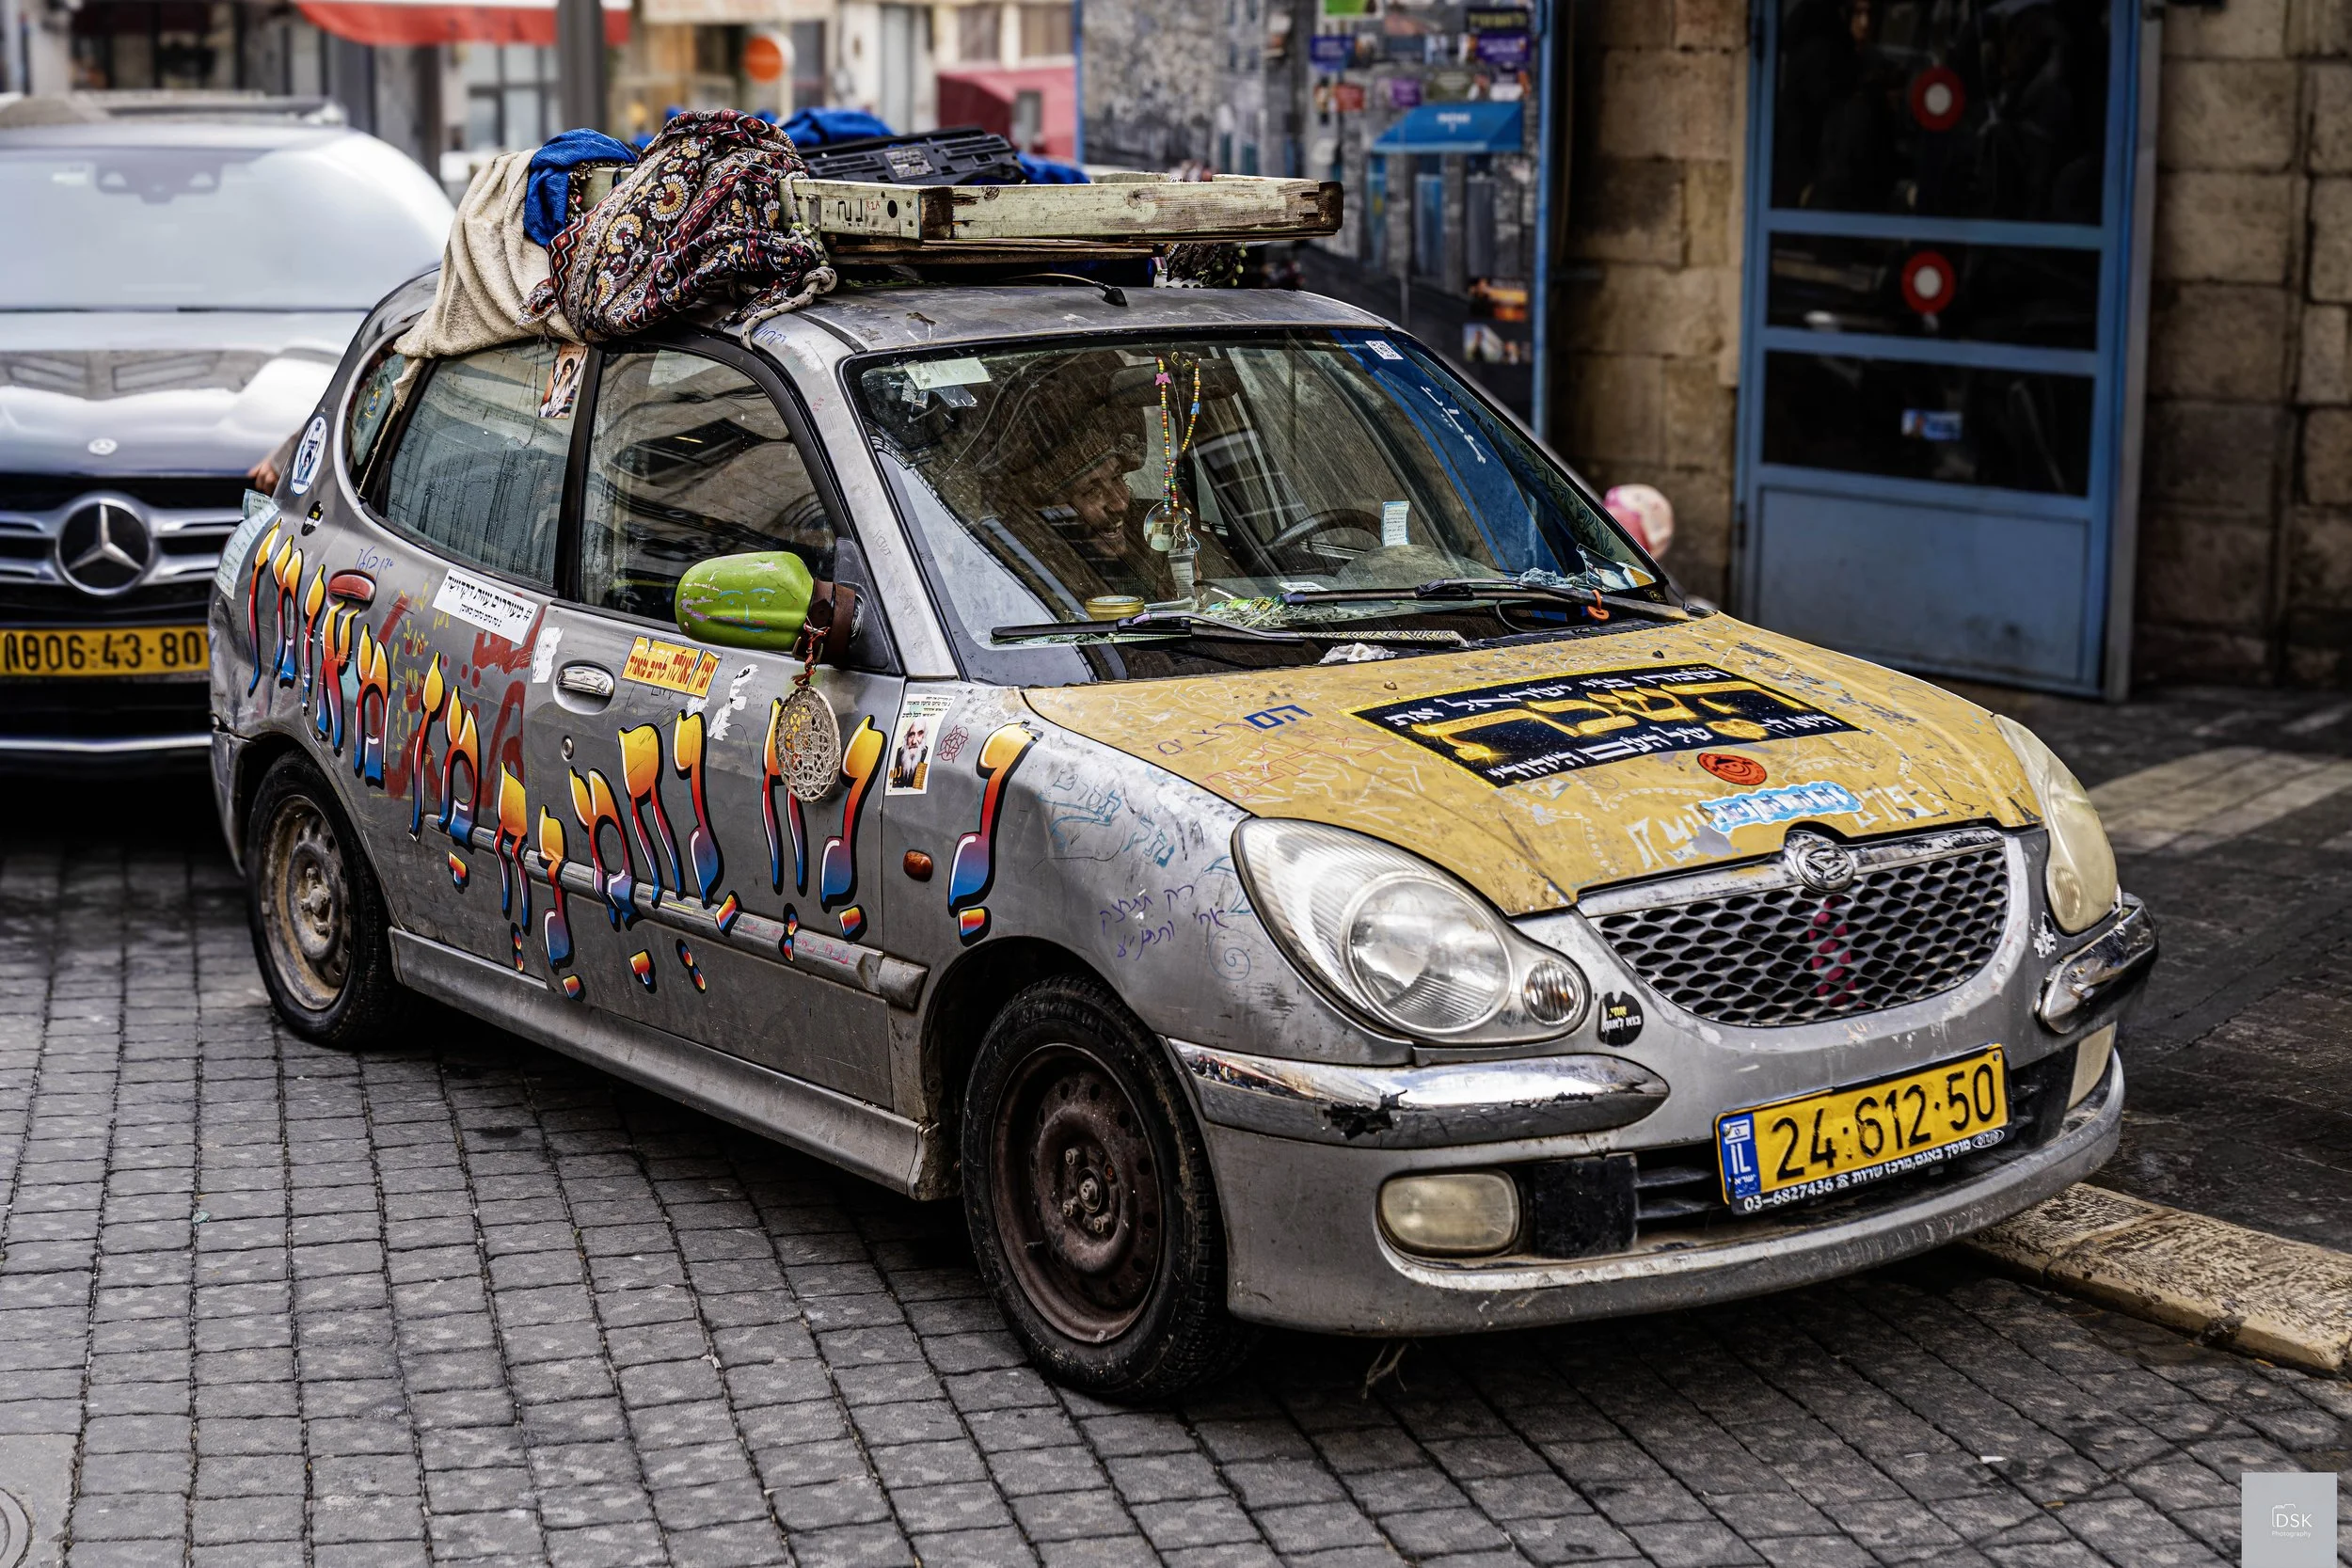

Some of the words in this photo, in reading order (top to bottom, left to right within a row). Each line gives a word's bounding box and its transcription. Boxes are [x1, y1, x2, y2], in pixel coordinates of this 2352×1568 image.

[1435, 684, 1571, 713] ישראל
[1385, 706, 1445, 727] את
[1411, 681, 1810, 763] השבת
[1731, 1143, 1751, 1174] IL
